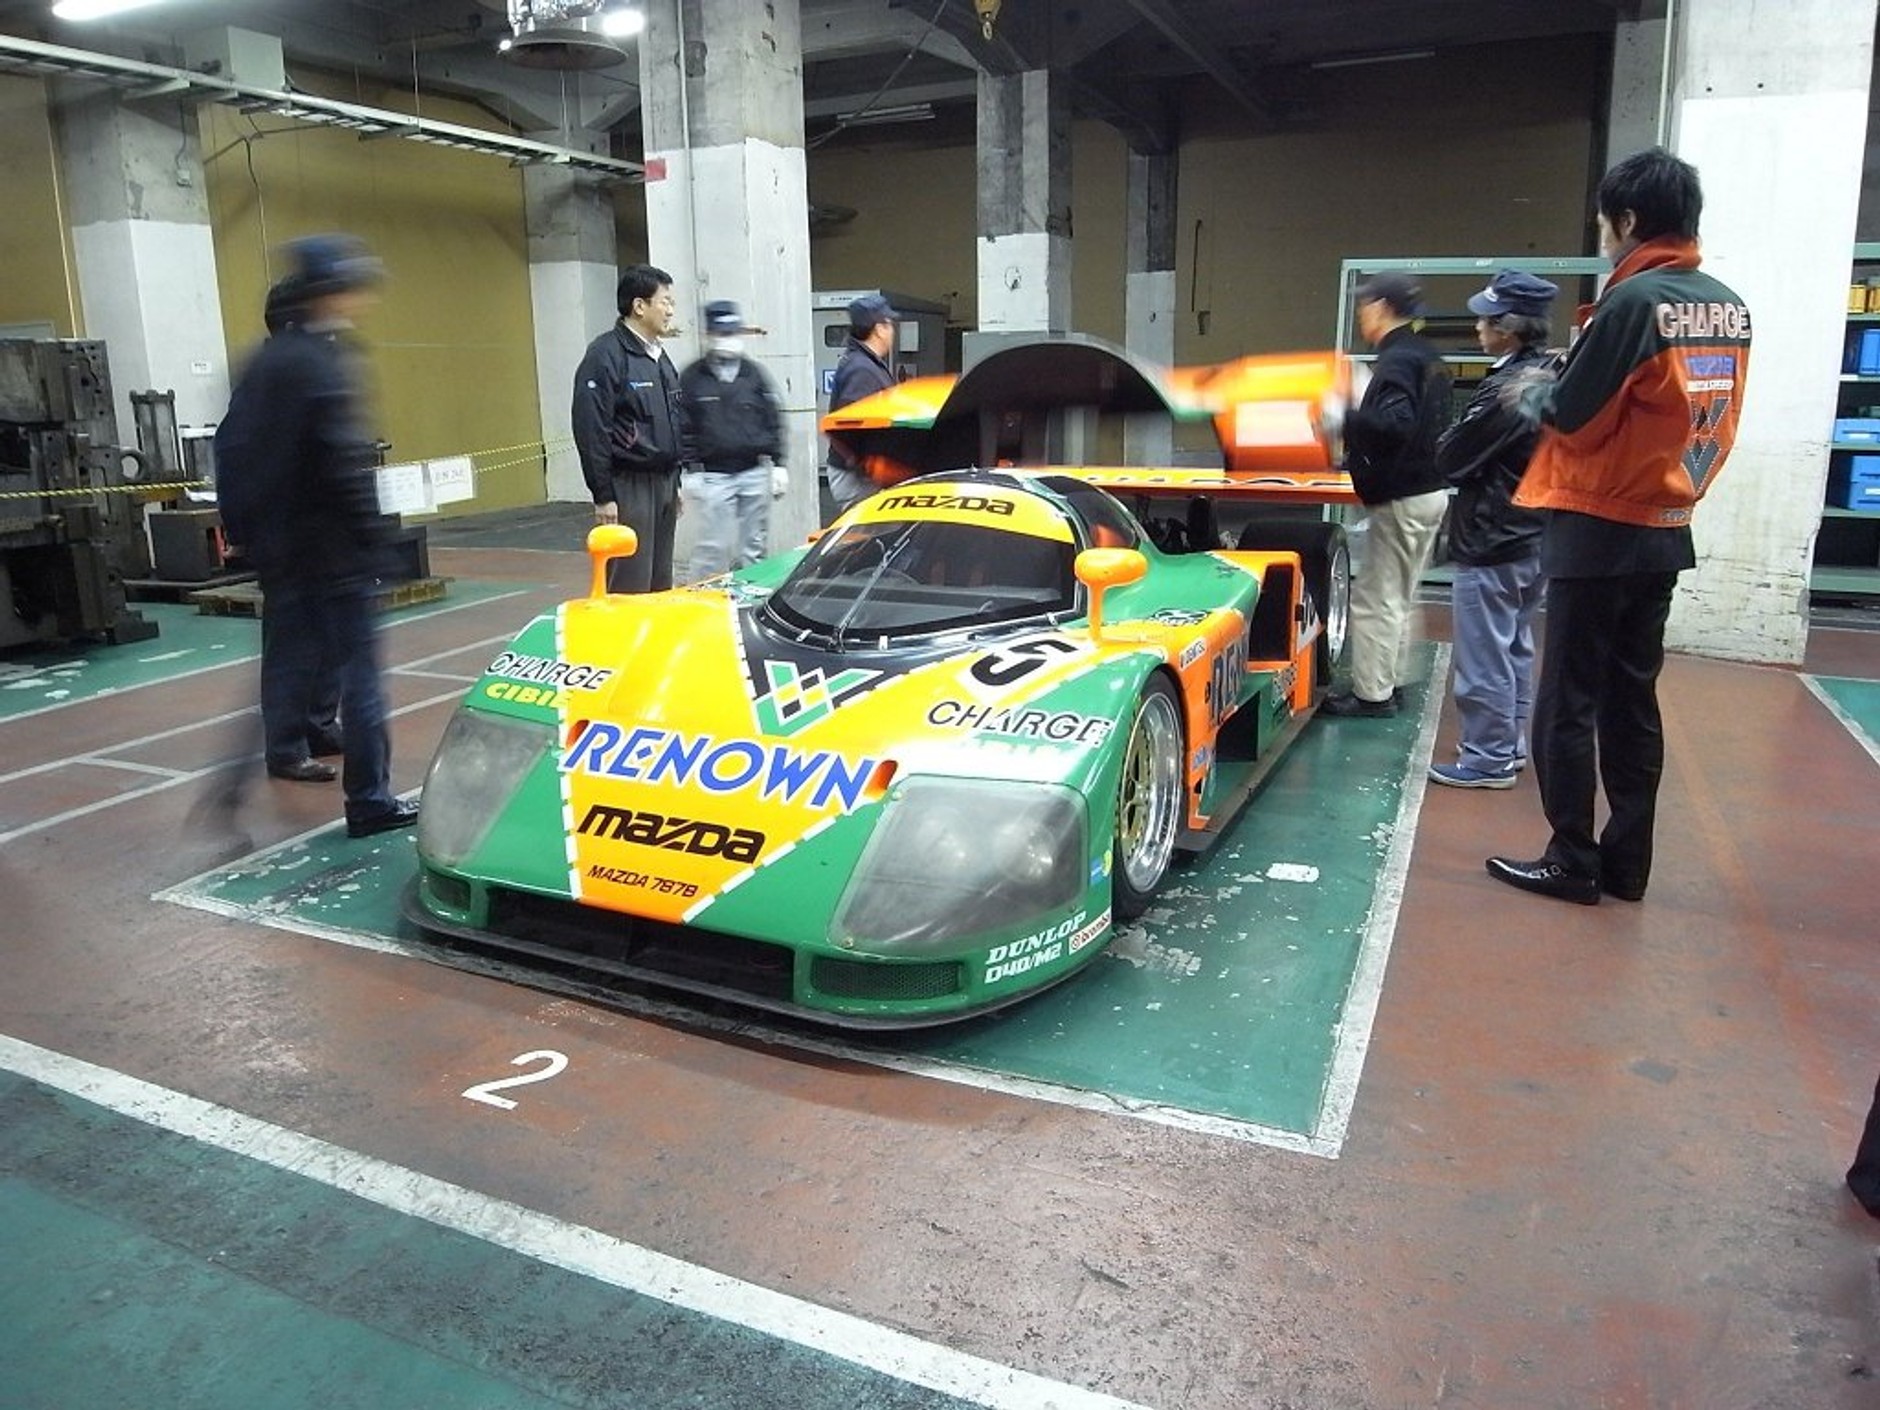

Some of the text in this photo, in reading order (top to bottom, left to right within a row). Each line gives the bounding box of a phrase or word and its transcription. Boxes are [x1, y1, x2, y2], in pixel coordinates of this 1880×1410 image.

[1657, 303, 1751, 339] CHARGE
[488, 653, 612, 690] CHARGE
[970, 639, 1079, 687] 5
[928, 701, 1112, 745] CHARGE
[564, 723, 875, 811] RENOWN
[587, 865, 699, 898] MAZDA 787B
[985, 911, 1086, 965] DUNLOP
[461, 1049, 568, 1110] 2
